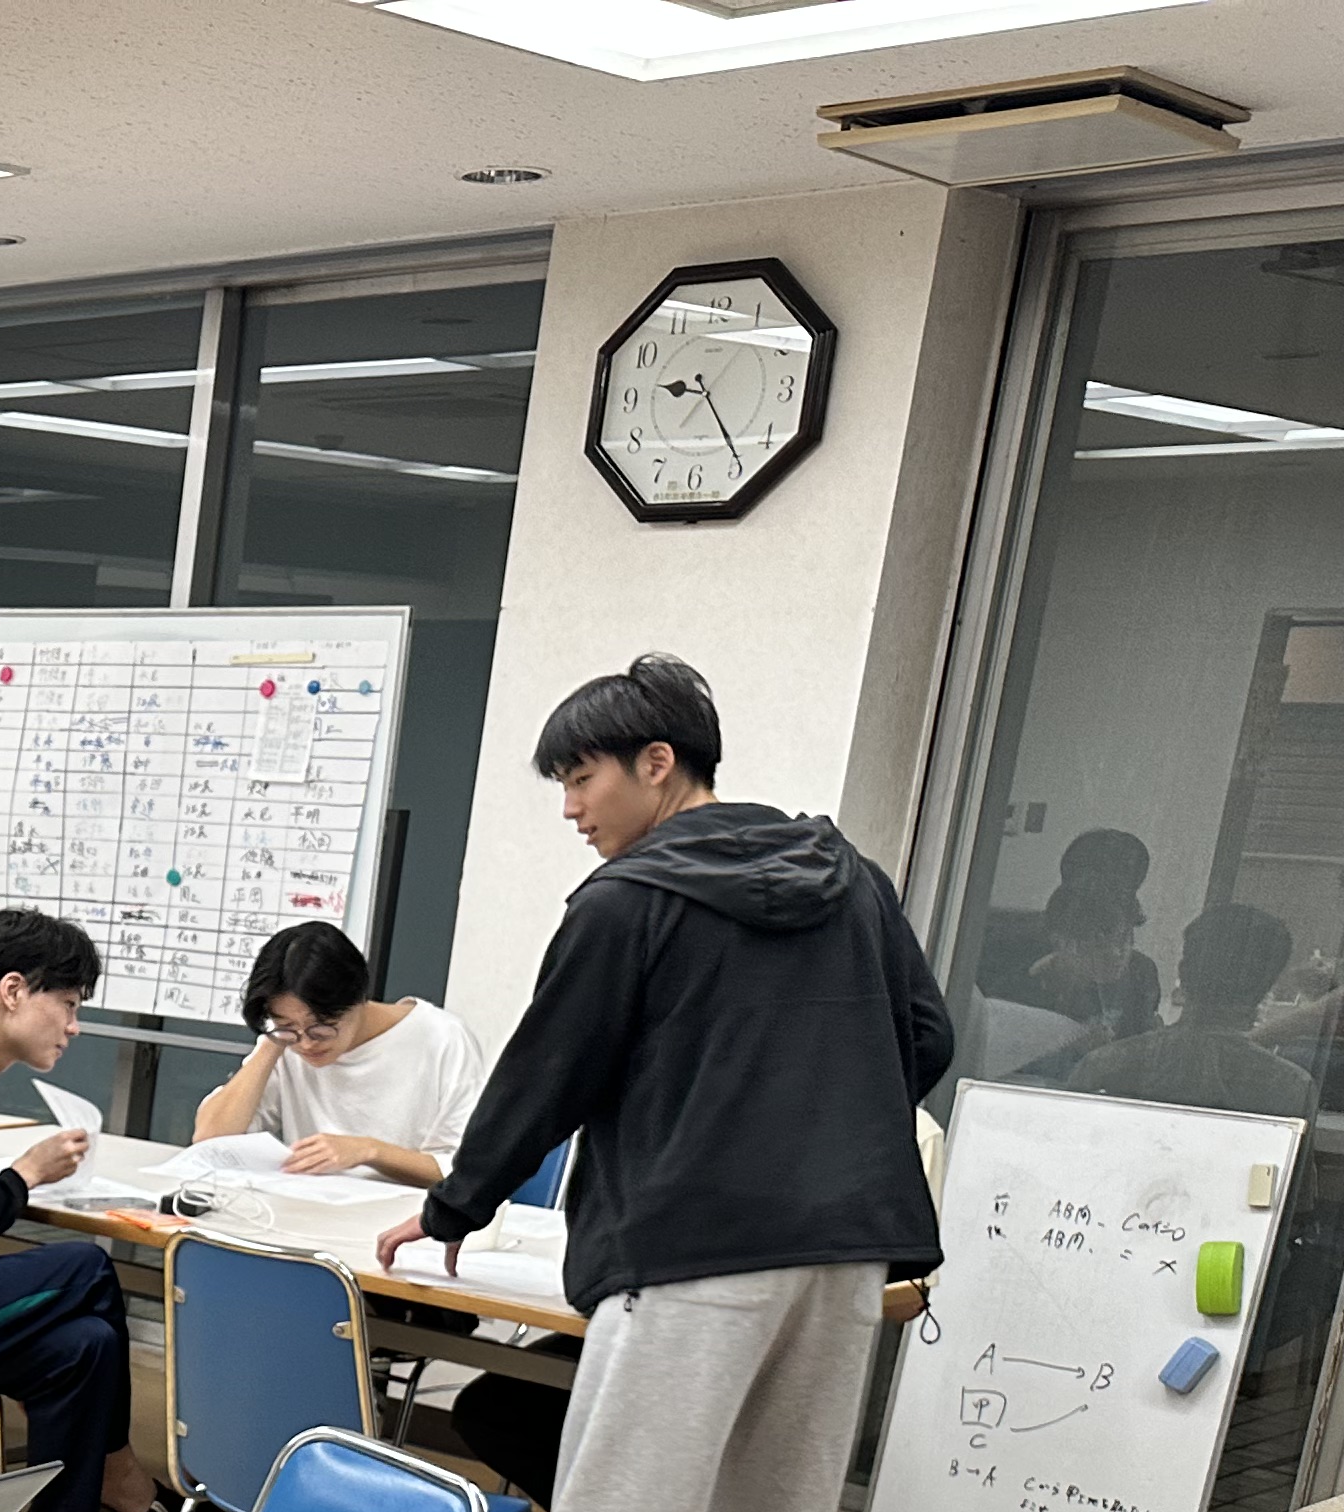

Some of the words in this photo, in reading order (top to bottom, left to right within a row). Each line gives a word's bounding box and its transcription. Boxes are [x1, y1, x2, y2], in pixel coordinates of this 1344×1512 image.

[670, 310, 687, 335] 11
[708, 296, 732, 324] 12
[753, 301, 762, 328] 1
[635, 341, 658, 369] 10
[623, 387, 639, 414] 9
[776, 375, 795, 403] 3
[627, 426, 643, 454] 8
[757, 421, 774, 450] 4
[652, 457, 667, 484] 7
[687, 464, 703, 490] 6
[727, 452, 743, 480] 5
